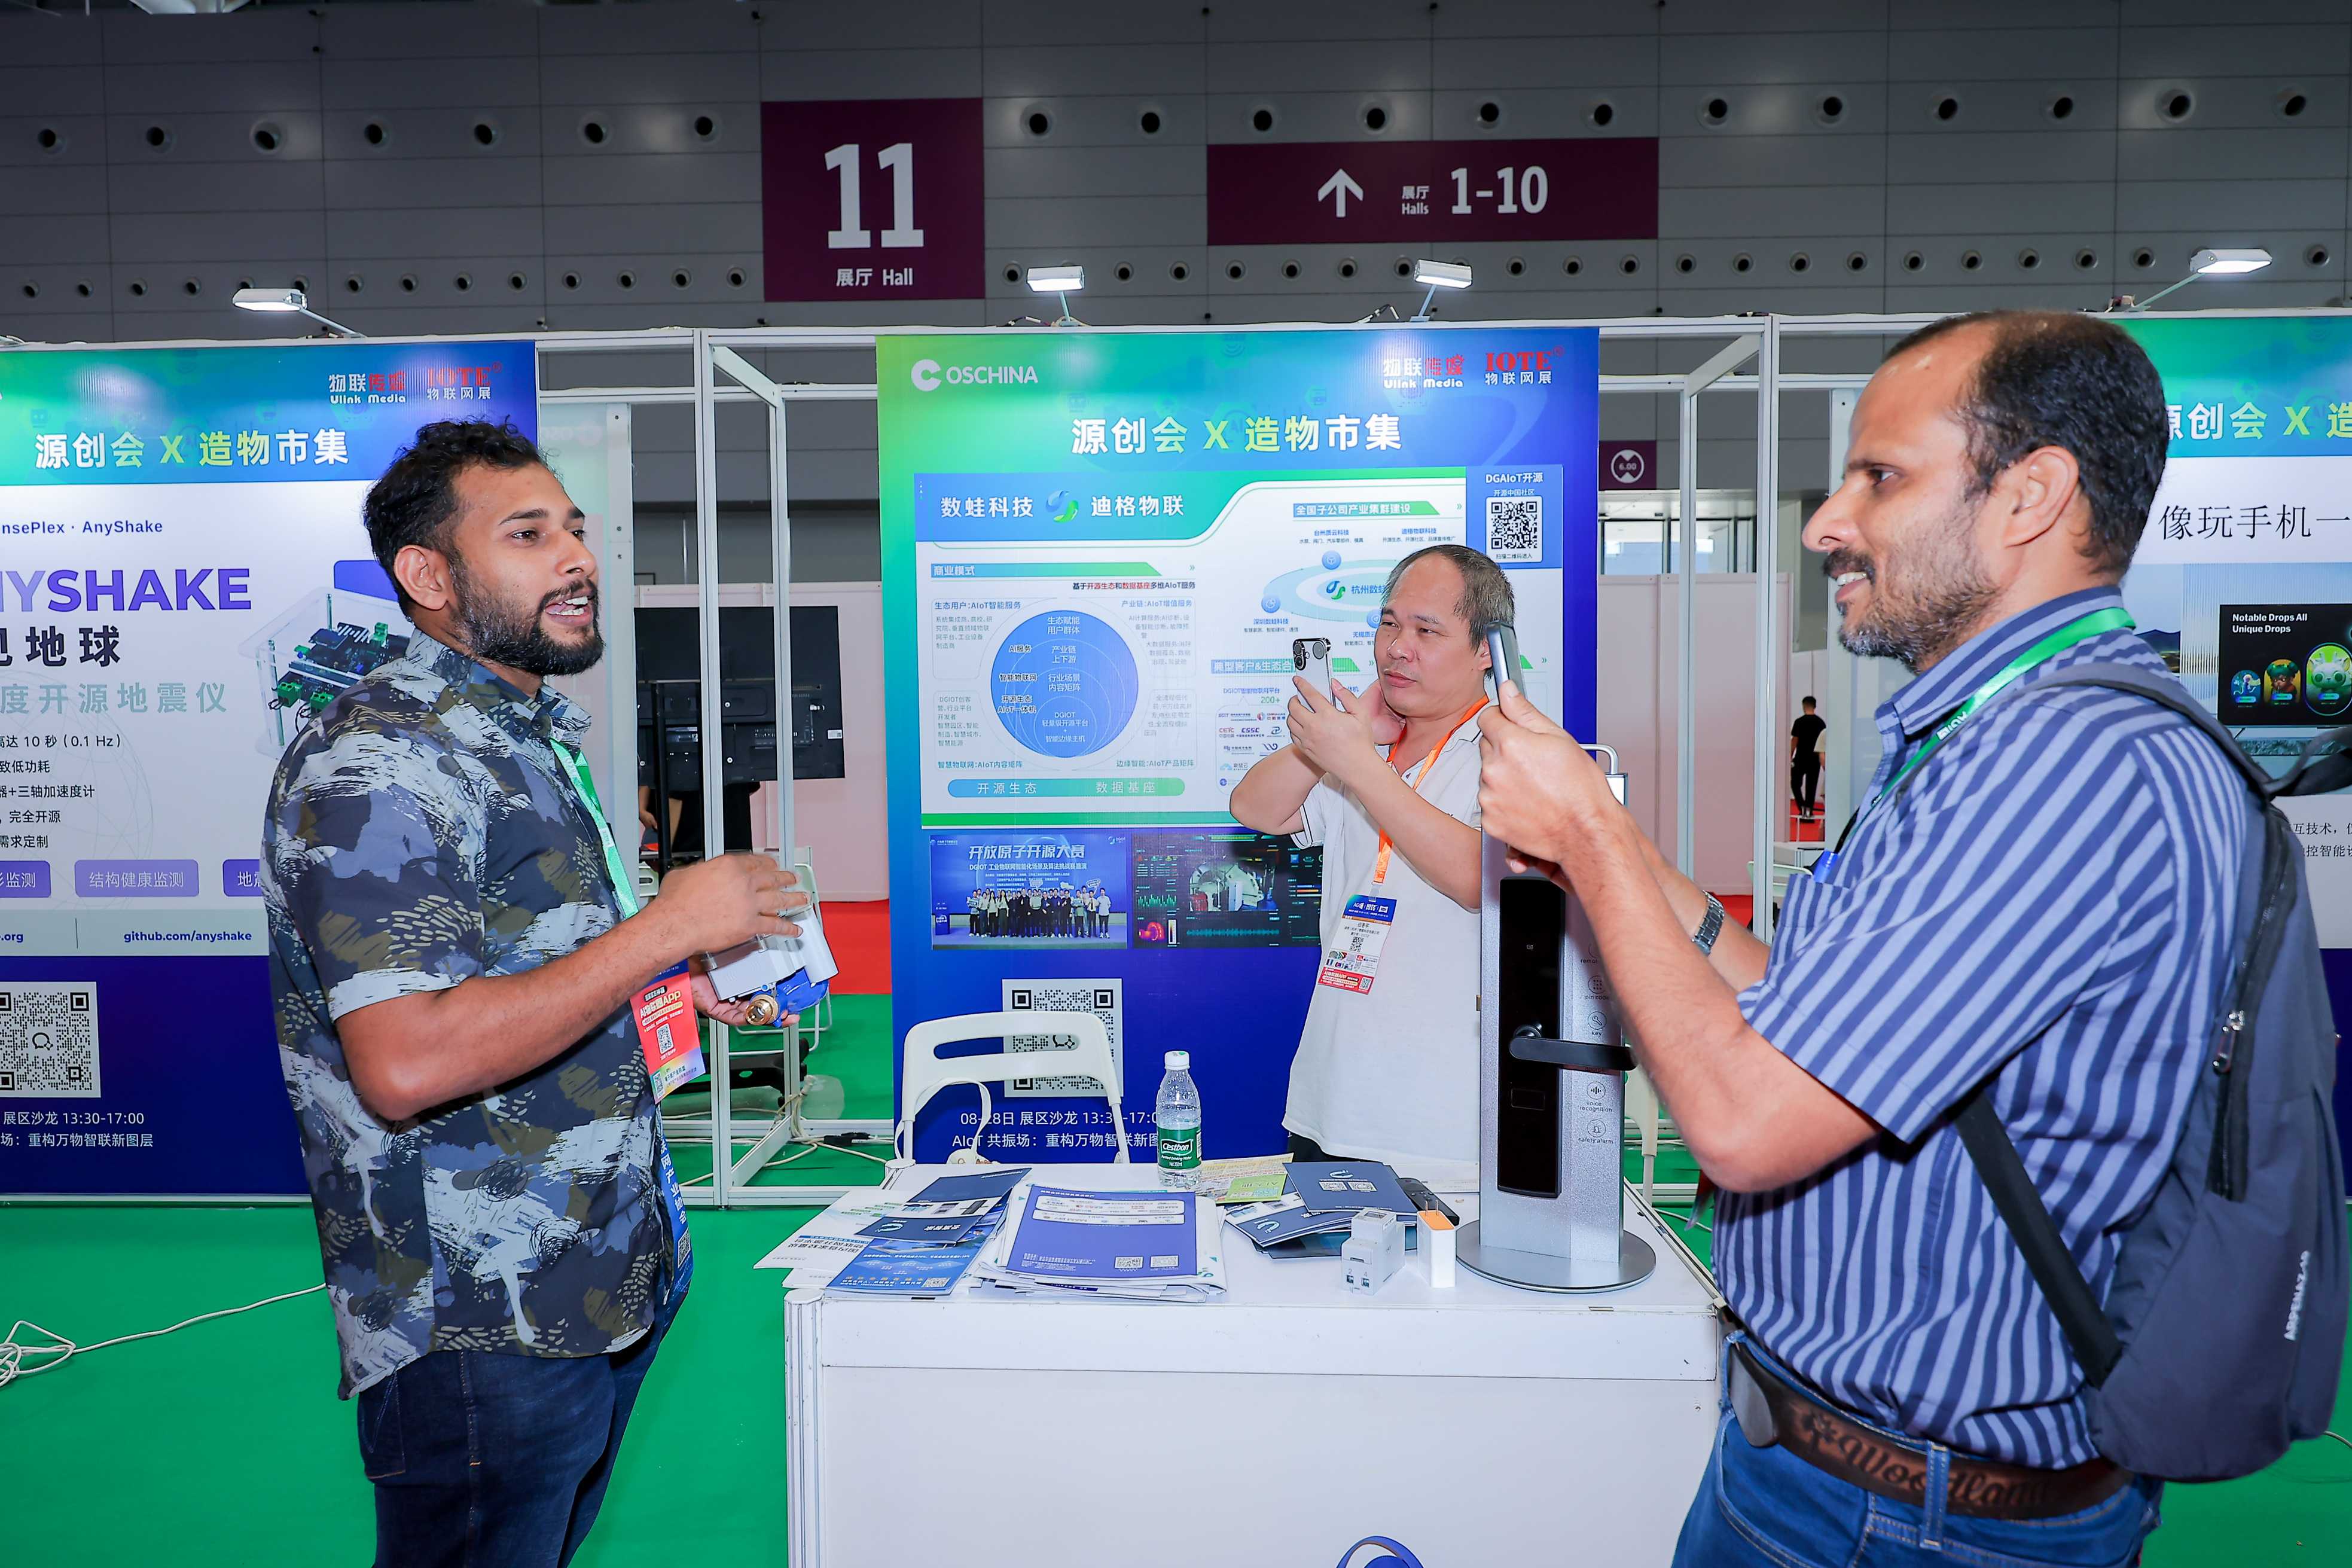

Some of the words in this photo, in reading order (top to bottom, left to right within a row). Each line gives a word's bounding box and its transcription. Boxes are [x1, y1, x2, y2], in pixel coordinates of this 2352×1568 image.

[825, 143, 924, 248] 11
[1402, 186, 1429, 200] 展厅
[1451, 166, 1548, 213] 1-10
[1402, 203, 1429, 215] Halls
[836, 269, 873, 286] 展厅
[883, 269, 913, 286] Hall
[1383, 354, 1464, 377] 物联传媒
[1485, 350, 1552, 371] IOTE
[329, 370, 407, 392] 物联传媒
[946, 365, 1038, 385] OSCHINA
[1485, 371, 1552, 385] 物联网展
[1384, 379, 1416, 389] Ulink
[1423, 379, 1463, 388] Media
[330, 395, 361, 404] Ulink
[368, 394, 405, 403] Media
[427, 387, 491, 400] 物联网展
[1072, 416, 1188, 454] 源创会
[1244, 414, 1401, 453] 造物市集
[35, 431, 145, 469] 源创会
[199, 428, 349, 467] 造物市集
[1619, 462, 1636, 471] 6.00
[1485, 471, 1543, 483] DGAIoT开源
[941, 496, 1033, 518] 数蛙科技
[1091, 495, 1183, 517] 迪格物联
[1296, 504, 1410, 515] 全国子公司产业集群建设
[83, 520, 163, 536] AnyShake
[2158, 504, 2350, 540] 像玩手机一
[934, 565, 975, 576] 商业模式
[0, 568, 251, 611] YSHAKE
[2232, 614, 2266, 622] Notable
[2268, 614, 2294, 623] Drops
[2296, 613, 2307, 622] All
[2232, 625, 2263, 634] Unique
[2265, 624, 2290, 634] Drops
[0, 682, 227, 714] 度开源地震仪
[24, 736, 40, 747] 10
[45, 735, 57, 748] 秒
[0, 761, 50, 773] 致低功耗
[978, 782, 1037, 794] 开源生态
[1096, 781, 1156, 793] 数据基座
[0, 835, 48, 848] 需求定制
[969, 844, 1085, 859] 开放原子开源大赛
[0, 872, 35, 887] 监测
[89, 872, 184, 888] 结构健康监测
[0, 934, 23, 943] .org
[124, 931, 252, 943] github.com/anyshake
[3, 1111, 58, 1125] 展区沙龙
[63, 1112, 144, 1124] 13:30-17:00
[961, 1112, 1014, 1125] 08-8日
[1020, 1111, 1078, 1125] 展区沙龙
